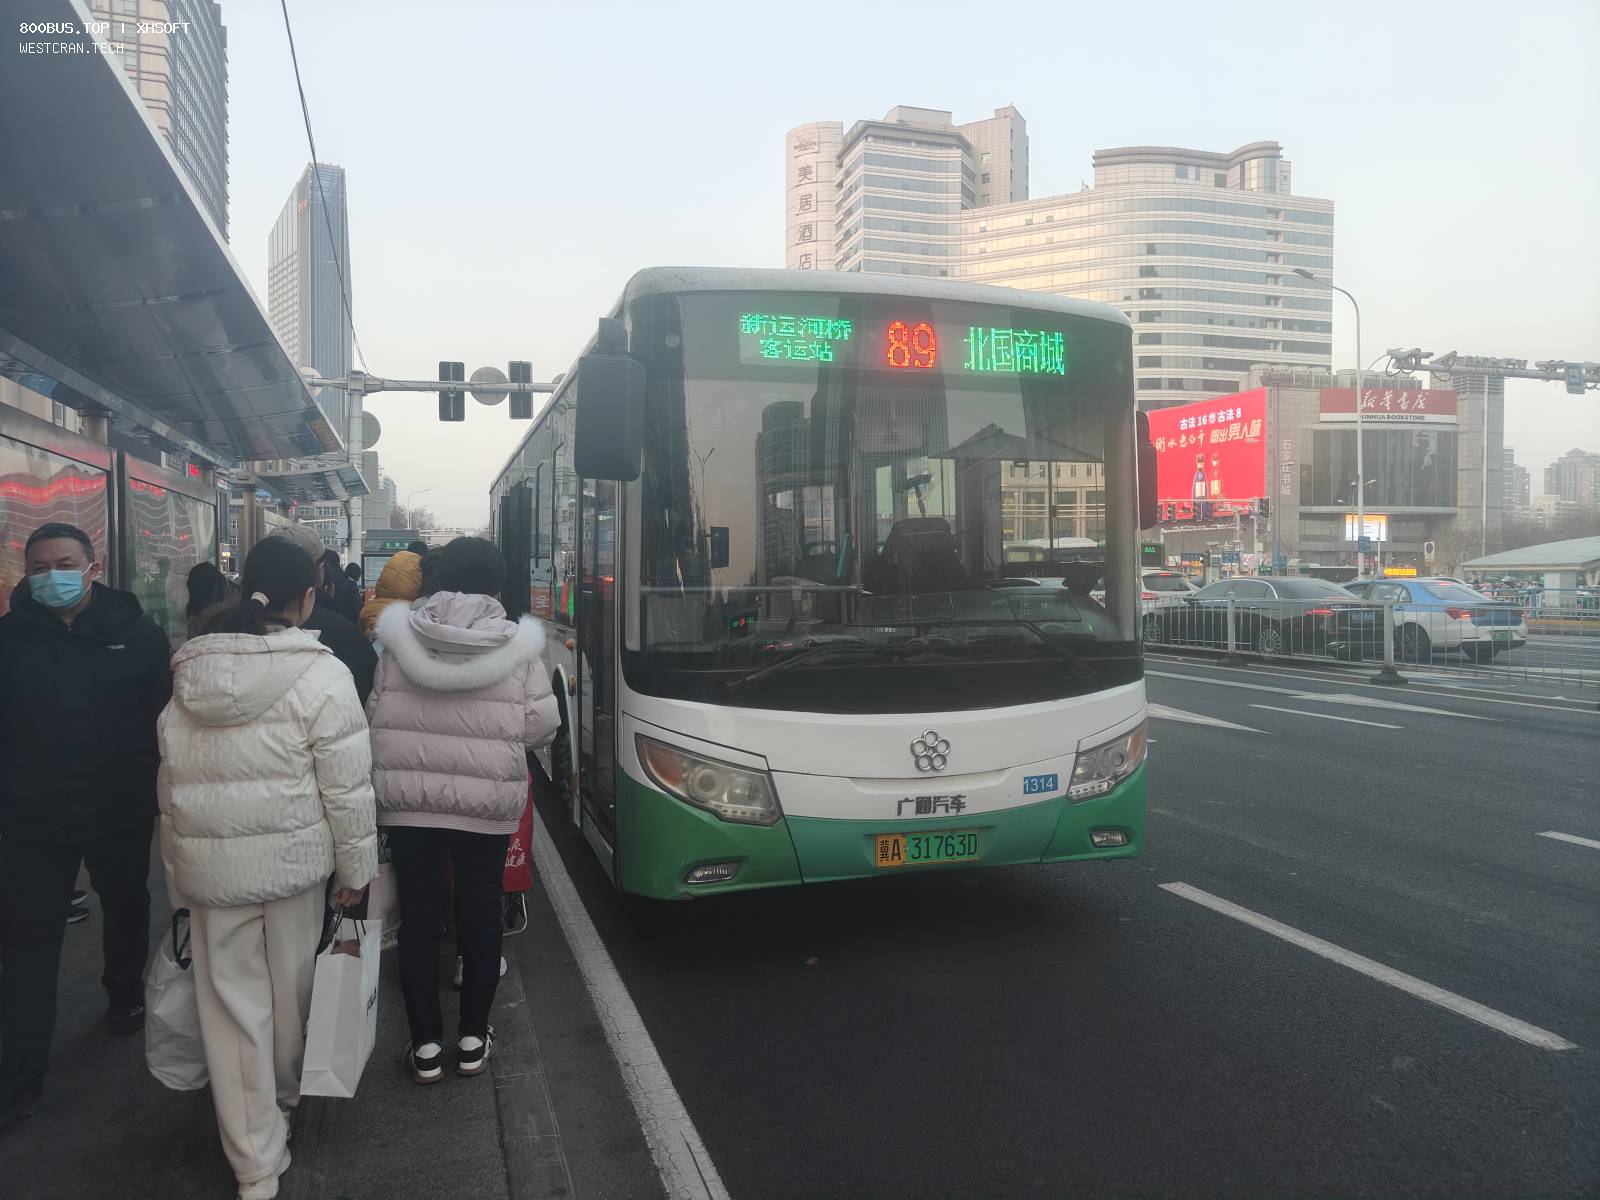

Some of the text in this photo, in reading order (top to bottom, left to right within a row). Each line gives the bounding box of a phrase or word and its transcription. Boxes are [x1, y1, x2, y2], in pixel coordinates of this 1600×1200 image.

[798, 165, 813, 270] 美居酒店
[759, 338, 834, 362] 客运站
[887, 319, 937, 369] 89
[963, 326, 1065, 376] 北国商城
[1024, 777, 1054, 793] 1314
[897, 794, 967, 817] 广通汽车
